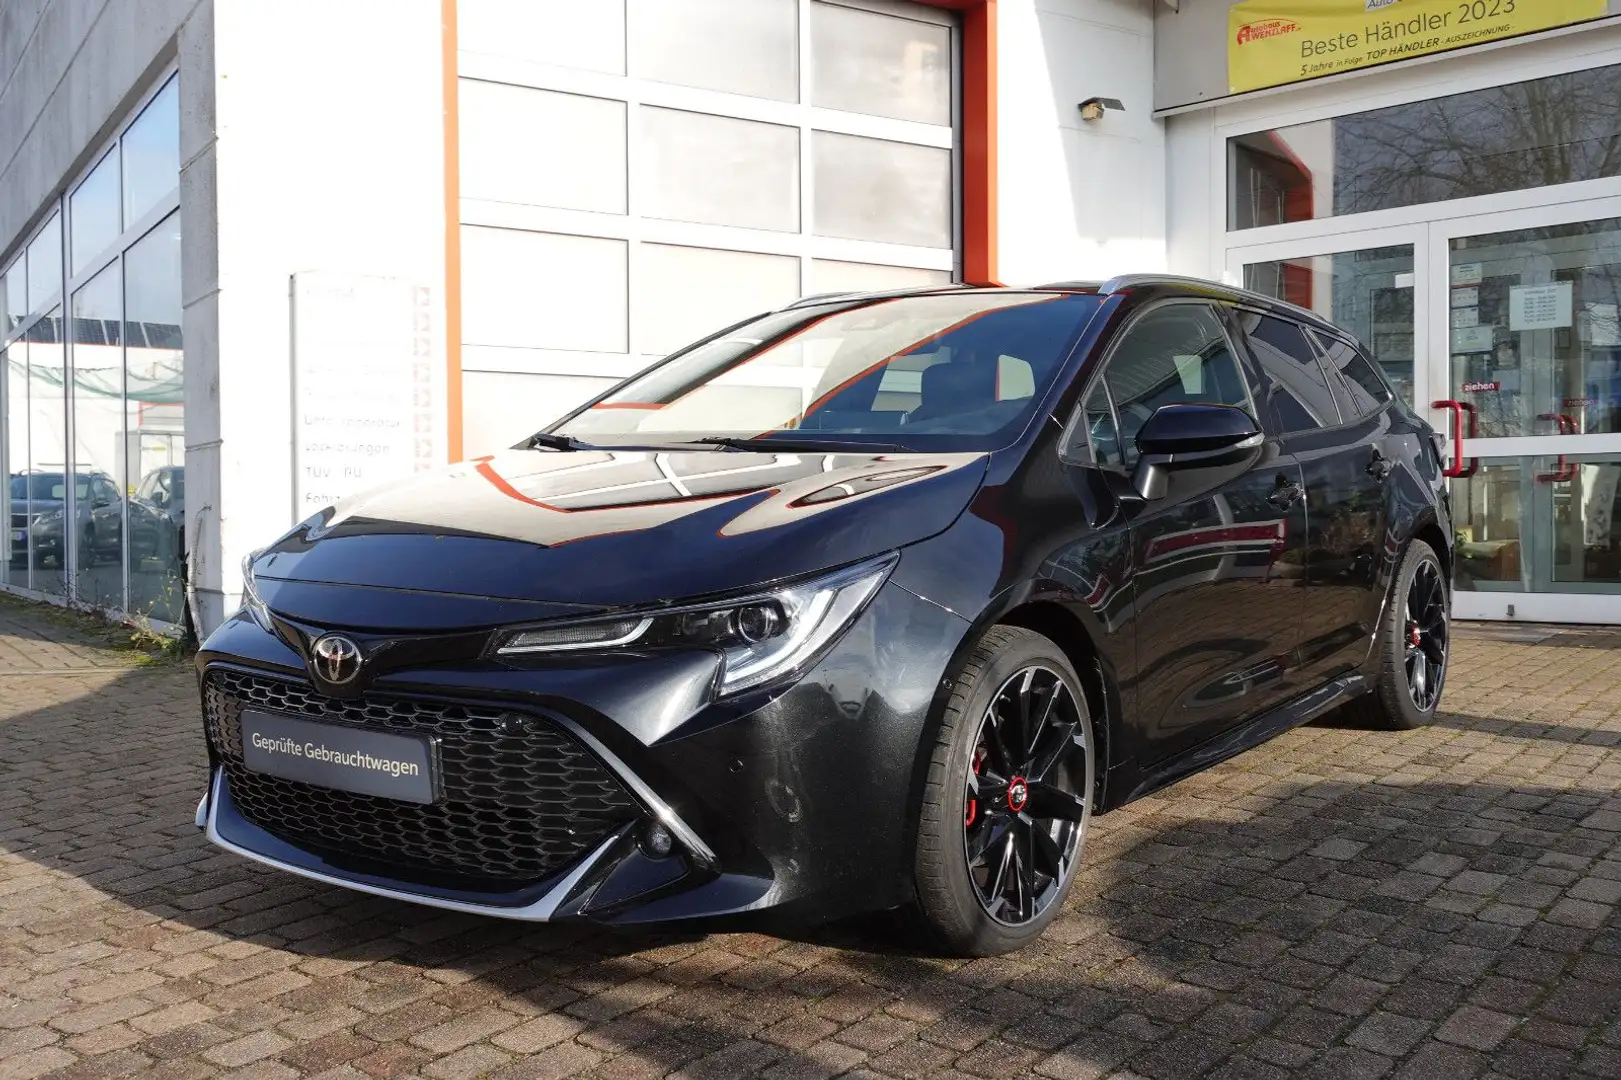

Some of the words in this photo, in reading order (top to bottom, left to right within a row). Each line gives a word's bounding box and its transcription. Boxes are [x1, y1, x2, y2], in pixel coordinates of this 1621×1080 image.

[1301, 33, 1358, 58] Beste
[1365, 11, 1451, 44] Händler
[1458, 0, 1515, 24] 2023
[1300, 64, 1308, 76] 5
[1309, 61, 1334, 73] Jahre
[1344, 56, 1363, 66] Folge
[1367, 49, 1387, 60] TOP
[1389, 38, 1440, 55] HÄNDLER
[1464, 381, 1495, 391] ziehen
[252, 732, 302, 756] Geprüfte
[304, 742, 419, 777] Gebrauchtwagen
